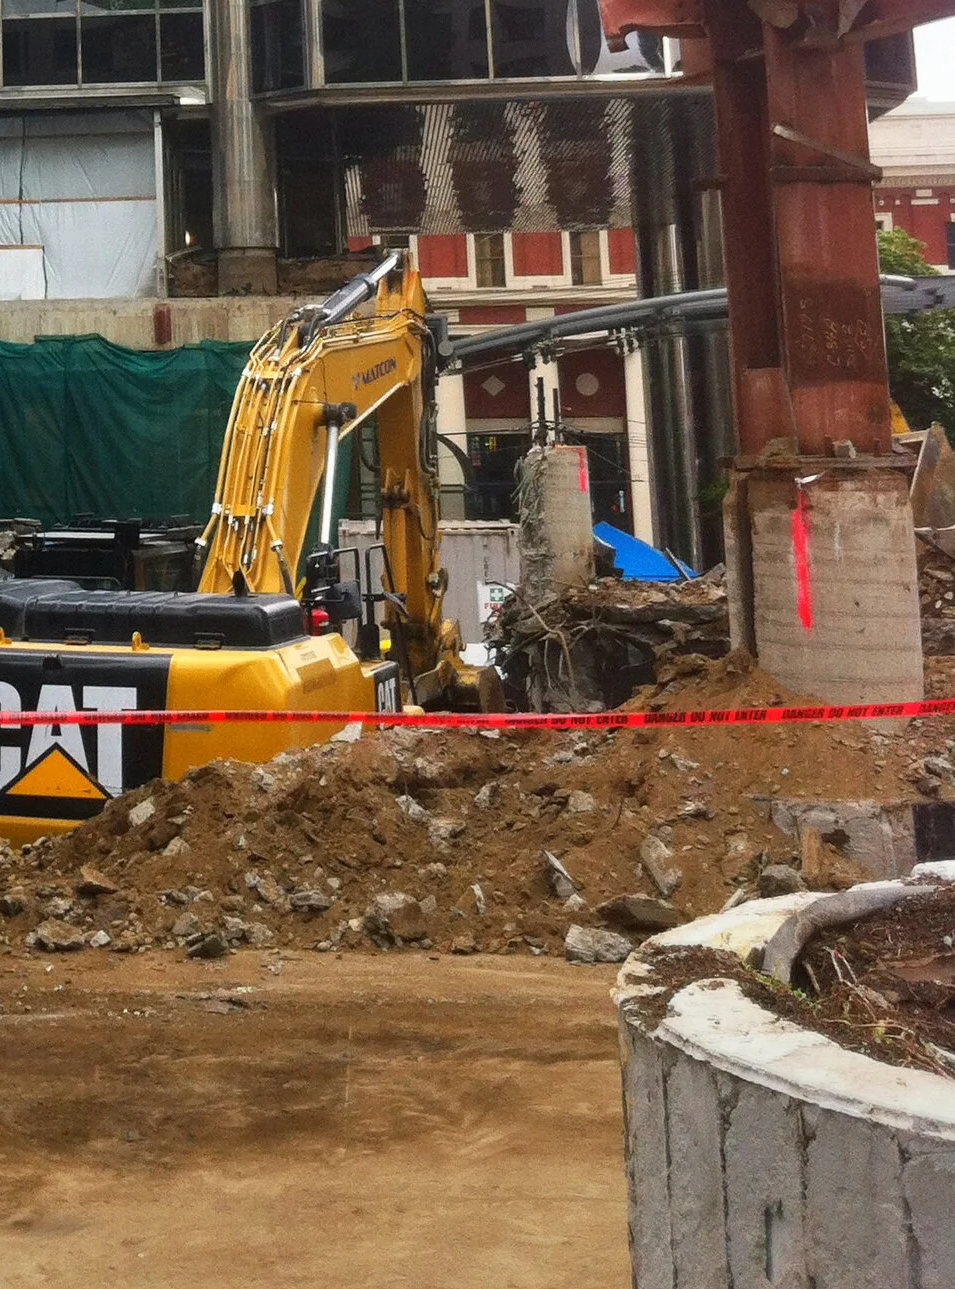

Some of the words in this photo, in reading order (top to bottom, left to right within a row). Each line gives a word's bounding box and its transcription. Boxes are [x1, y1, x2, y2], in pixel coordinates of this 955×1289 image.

[362, 356, 397, 384] MATCON
[378, 677, 396, 713] CAT
[644, 712, 686, 723] DANGER
[690, 711, 705, 722] DO
[709, 710, 730, 721] NOT
[735, 709, 767, 721] ENTER
[782, 708, 825, 718] DANGER
[828, 707, 844, 717] DO
[848, 706, 868, 717] NOT
[871, 705, 904, 716] ENTER
